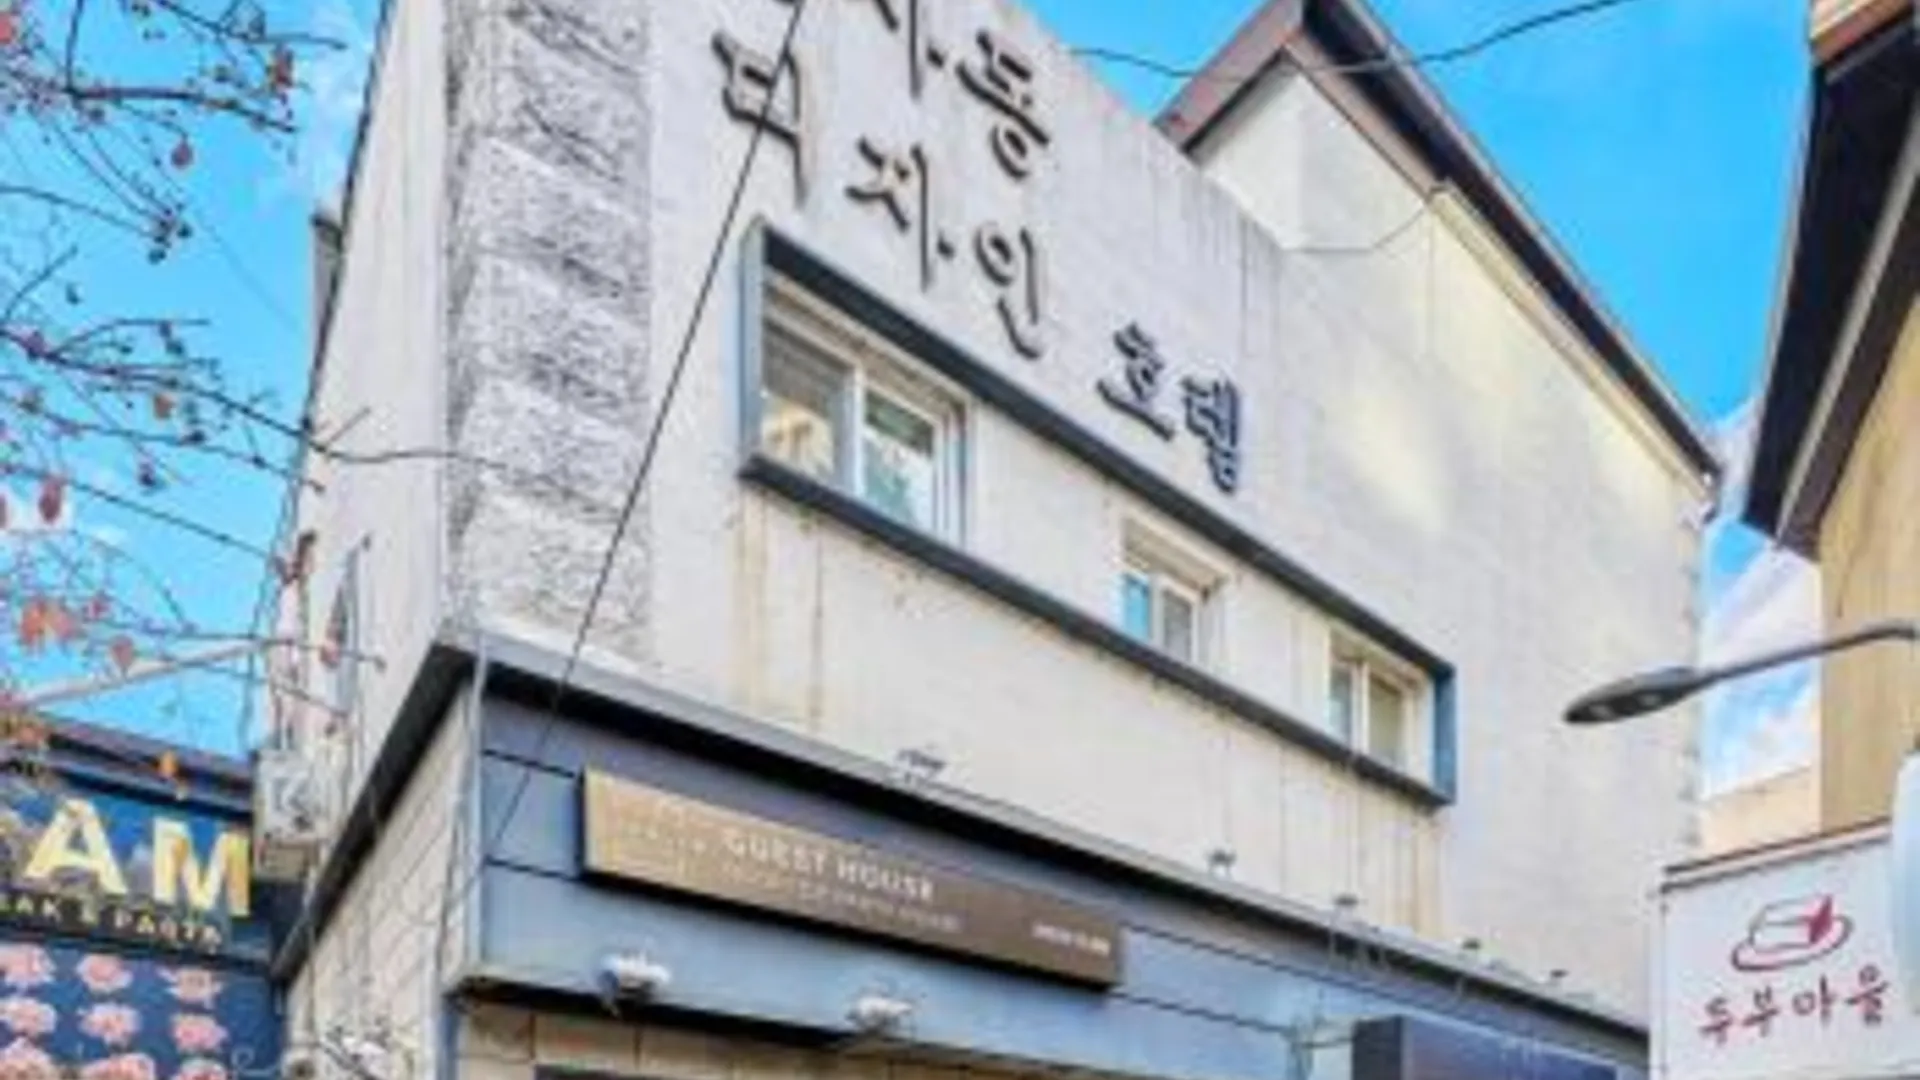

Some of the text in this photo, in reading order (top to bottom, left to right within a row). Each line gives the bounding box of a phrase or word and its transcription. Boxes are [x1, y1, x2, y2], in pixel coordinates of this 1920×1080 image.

[1096, 321, 1241, 496] 호텔
[723, 828, 827, 875] GUEST
[837, 856, 934, 900] HOUSE
[1698, 965, 1889, 1045] 두부마을
